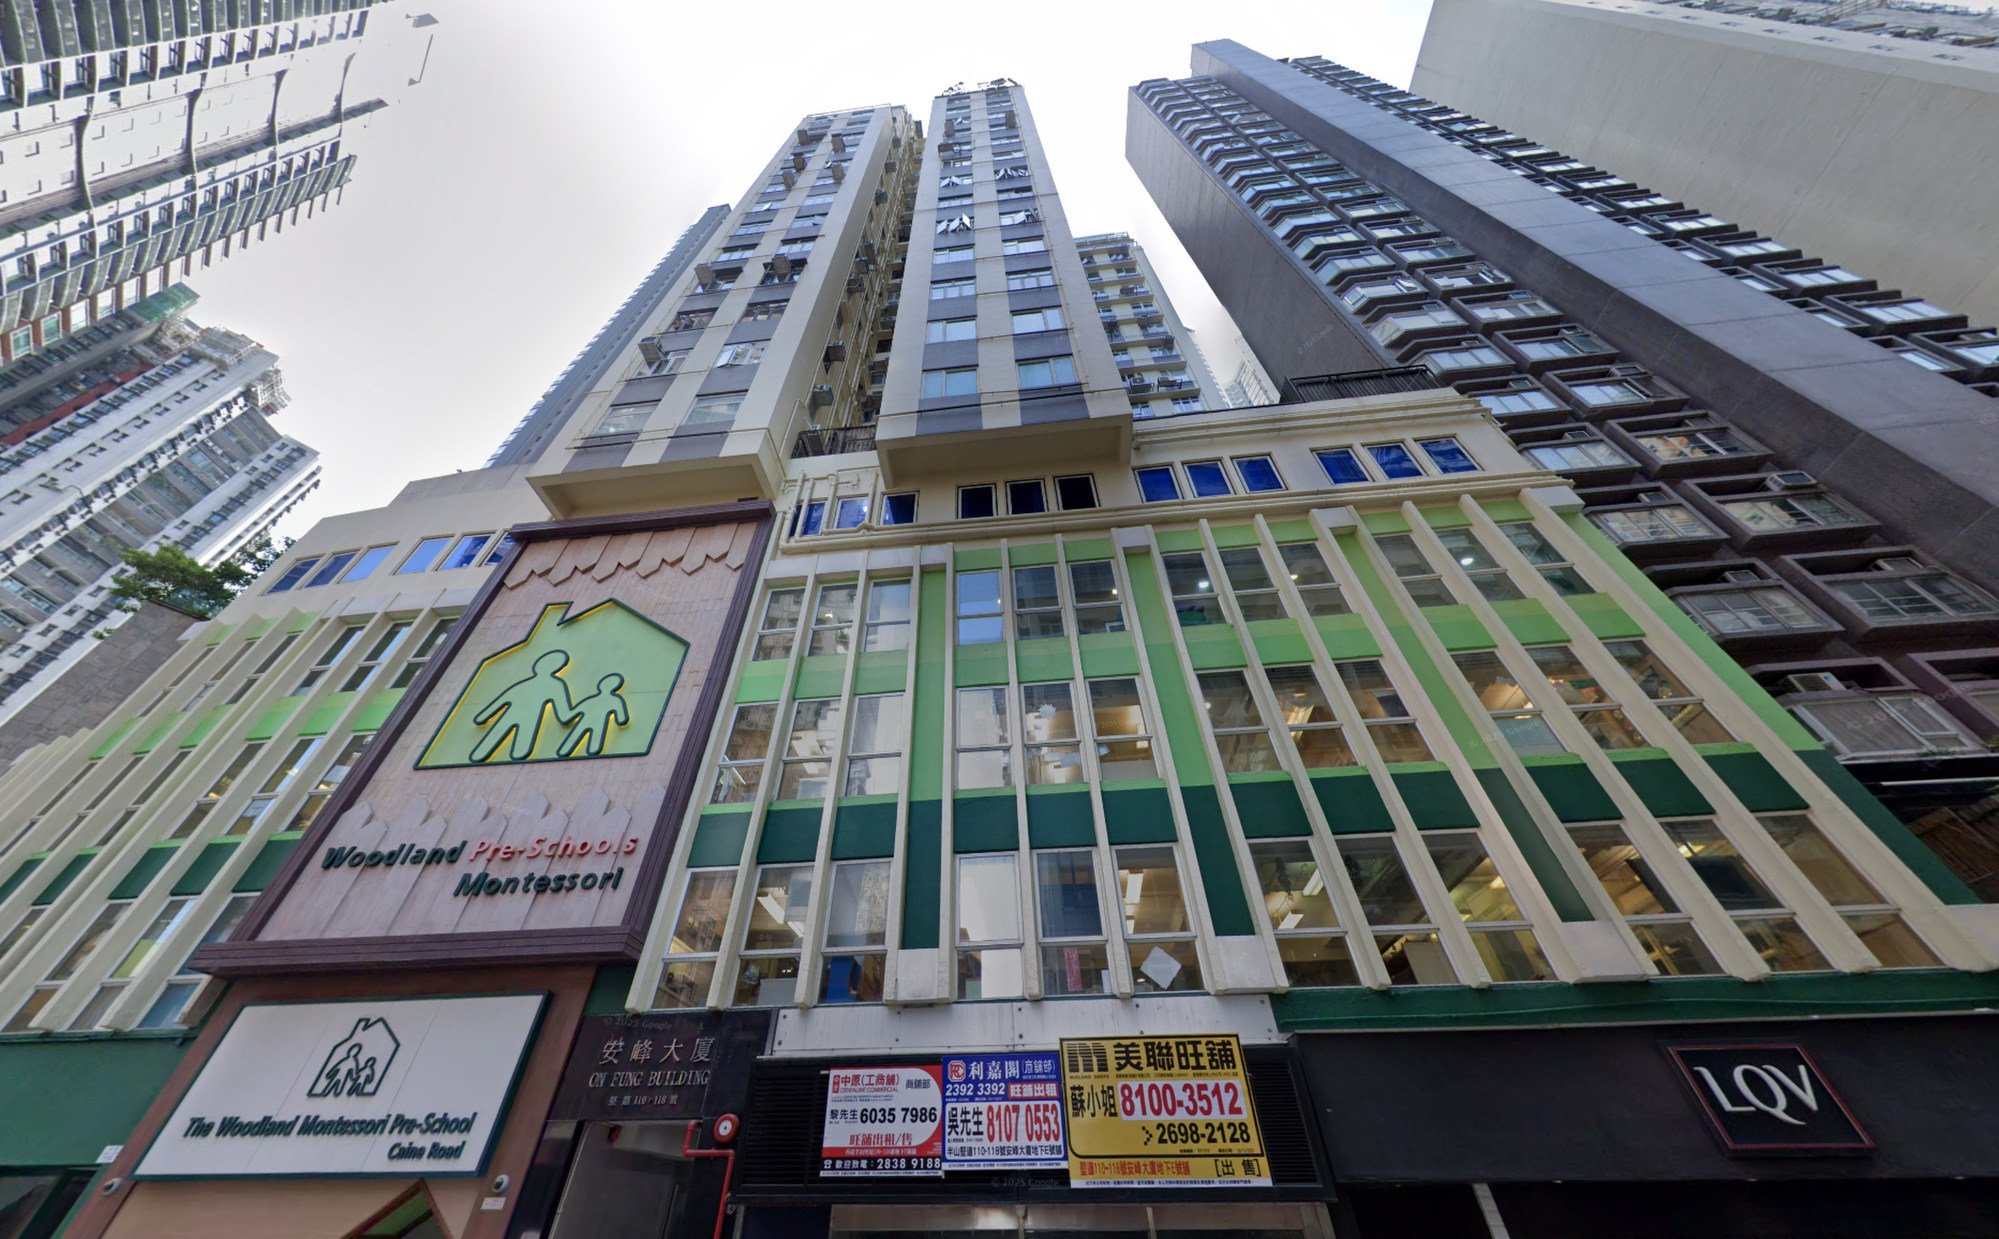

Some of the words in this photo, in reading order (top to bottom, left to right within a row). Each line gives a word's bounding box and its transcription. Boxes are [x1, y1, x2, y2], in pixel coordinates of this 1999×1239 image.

[321, 840, 468, 870] Woodland
[469, 832, 638, 862] Pre-Schools
[453, 867, 624, 898] Montessori
[599, 1037, 715, 1065] 安峰大廈
[1113, 1040, 1237, 1072] 美聯旺舖
[589, 1072, 606, 1088] ON
[610, 1071, 643, 1087] FUNG
[647, 1070, 711, 1087] BUILDING
[968, 1060, 1020, 1080] 利嘉閣
[945, 1083, 974, 1096] 2392
[977, 1082, 1005, 1096] 3392
[1010, 1083, 1057, 1097] 旺舖出租
[1070, 1084, 1118, 1118] 蘇小姐
[1120, 1082, 1243, 1117] 8100-3512
[1692, 1064, 1819, 1125] LQV
[183, 1116, 215, 1138] The
[215, 1115, 301, 1138] Woodland
[297, 1113, 391, 1137] Montessori
[388, 1111, 478, 1136] Pre-School
[860, 1107, 896, 1124] 6035
[901, 1107, 938, 1123] 7986
[948, 1106, 983, 1136] 吳先生
[987, 1104, 1020, 1143] 8107
[1025, 1103, 1060, 1142] 0553
[1156, 1121, 1251, 1145] 2698-2128
[387, 1142, 426, 1161] Caine
[427, 1140, 467, 1160] Road
[877, 1158, 906, 1169] 2838
[911, 1158, 941, 1169] 9188
